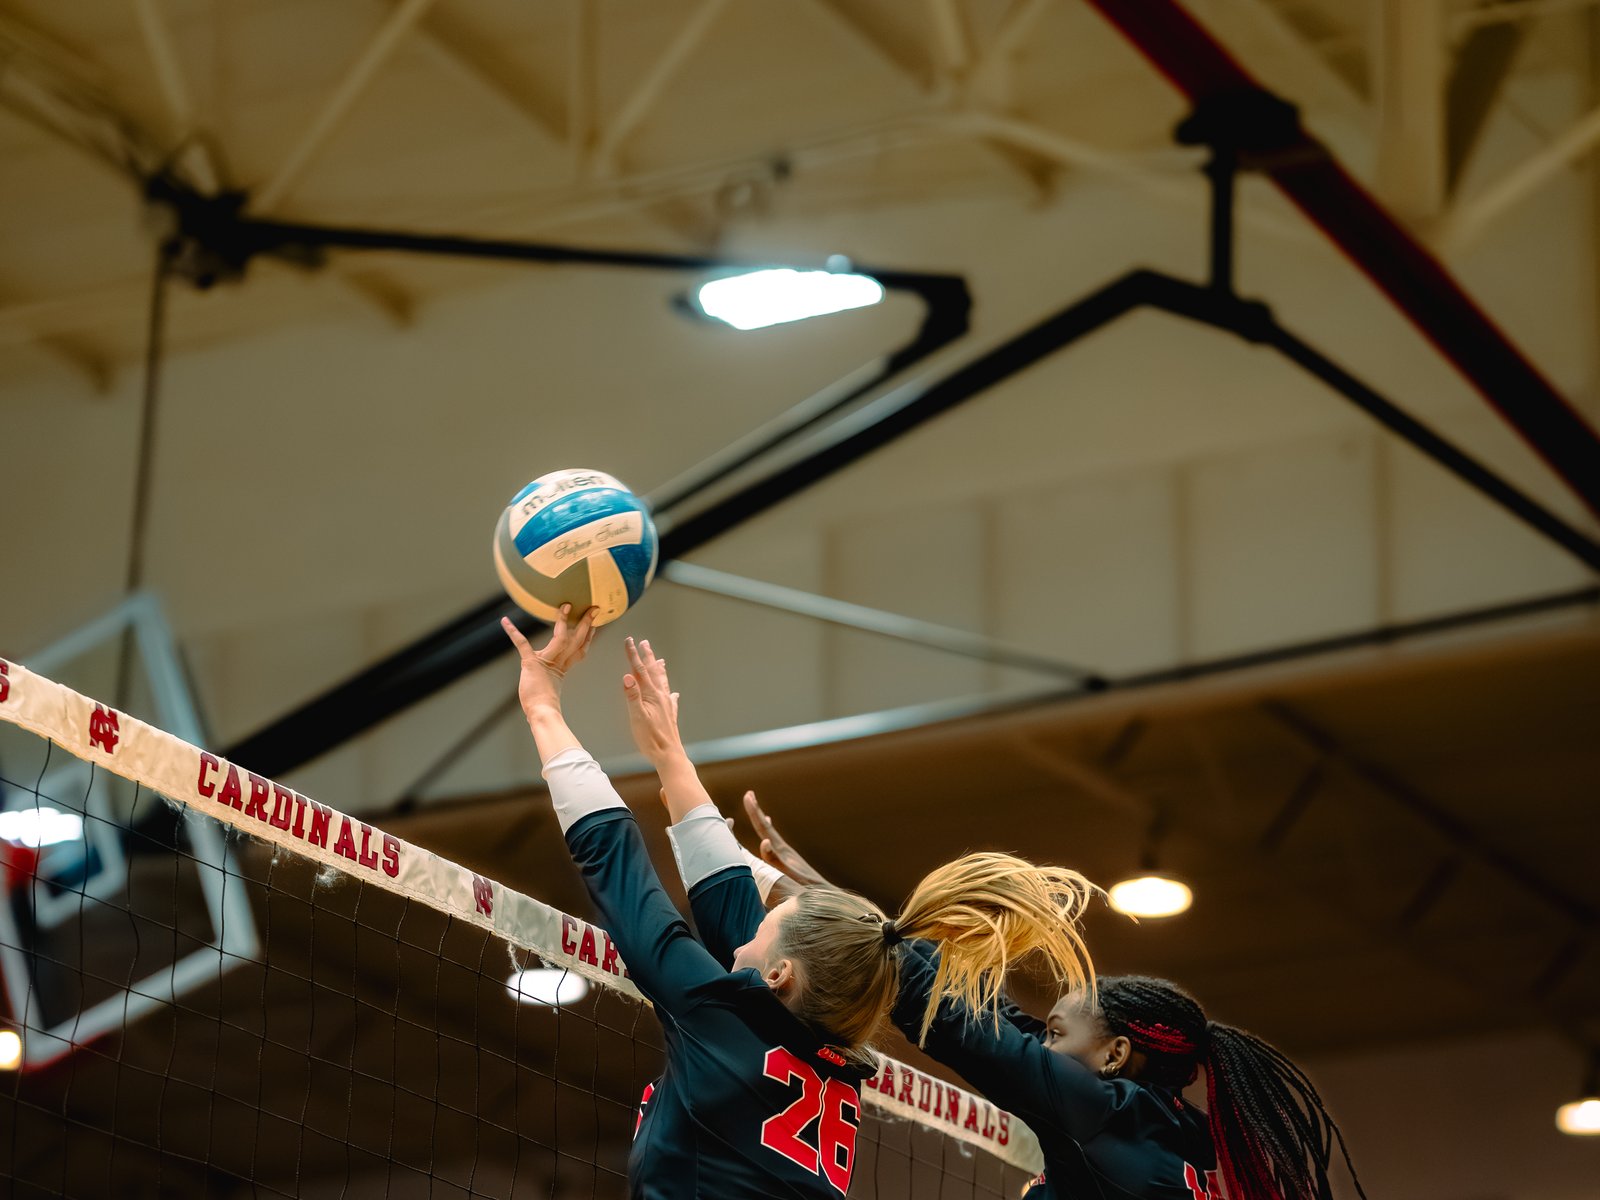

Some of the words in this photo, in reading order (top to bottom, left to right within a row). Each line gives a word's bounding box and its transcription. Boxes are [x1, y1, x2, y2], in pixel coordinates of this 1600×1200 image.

[197, 751, 401, 878] CARDINALS
[561, 913, 631, 977] CAR
[761, 1045, 861, 1197] 26
